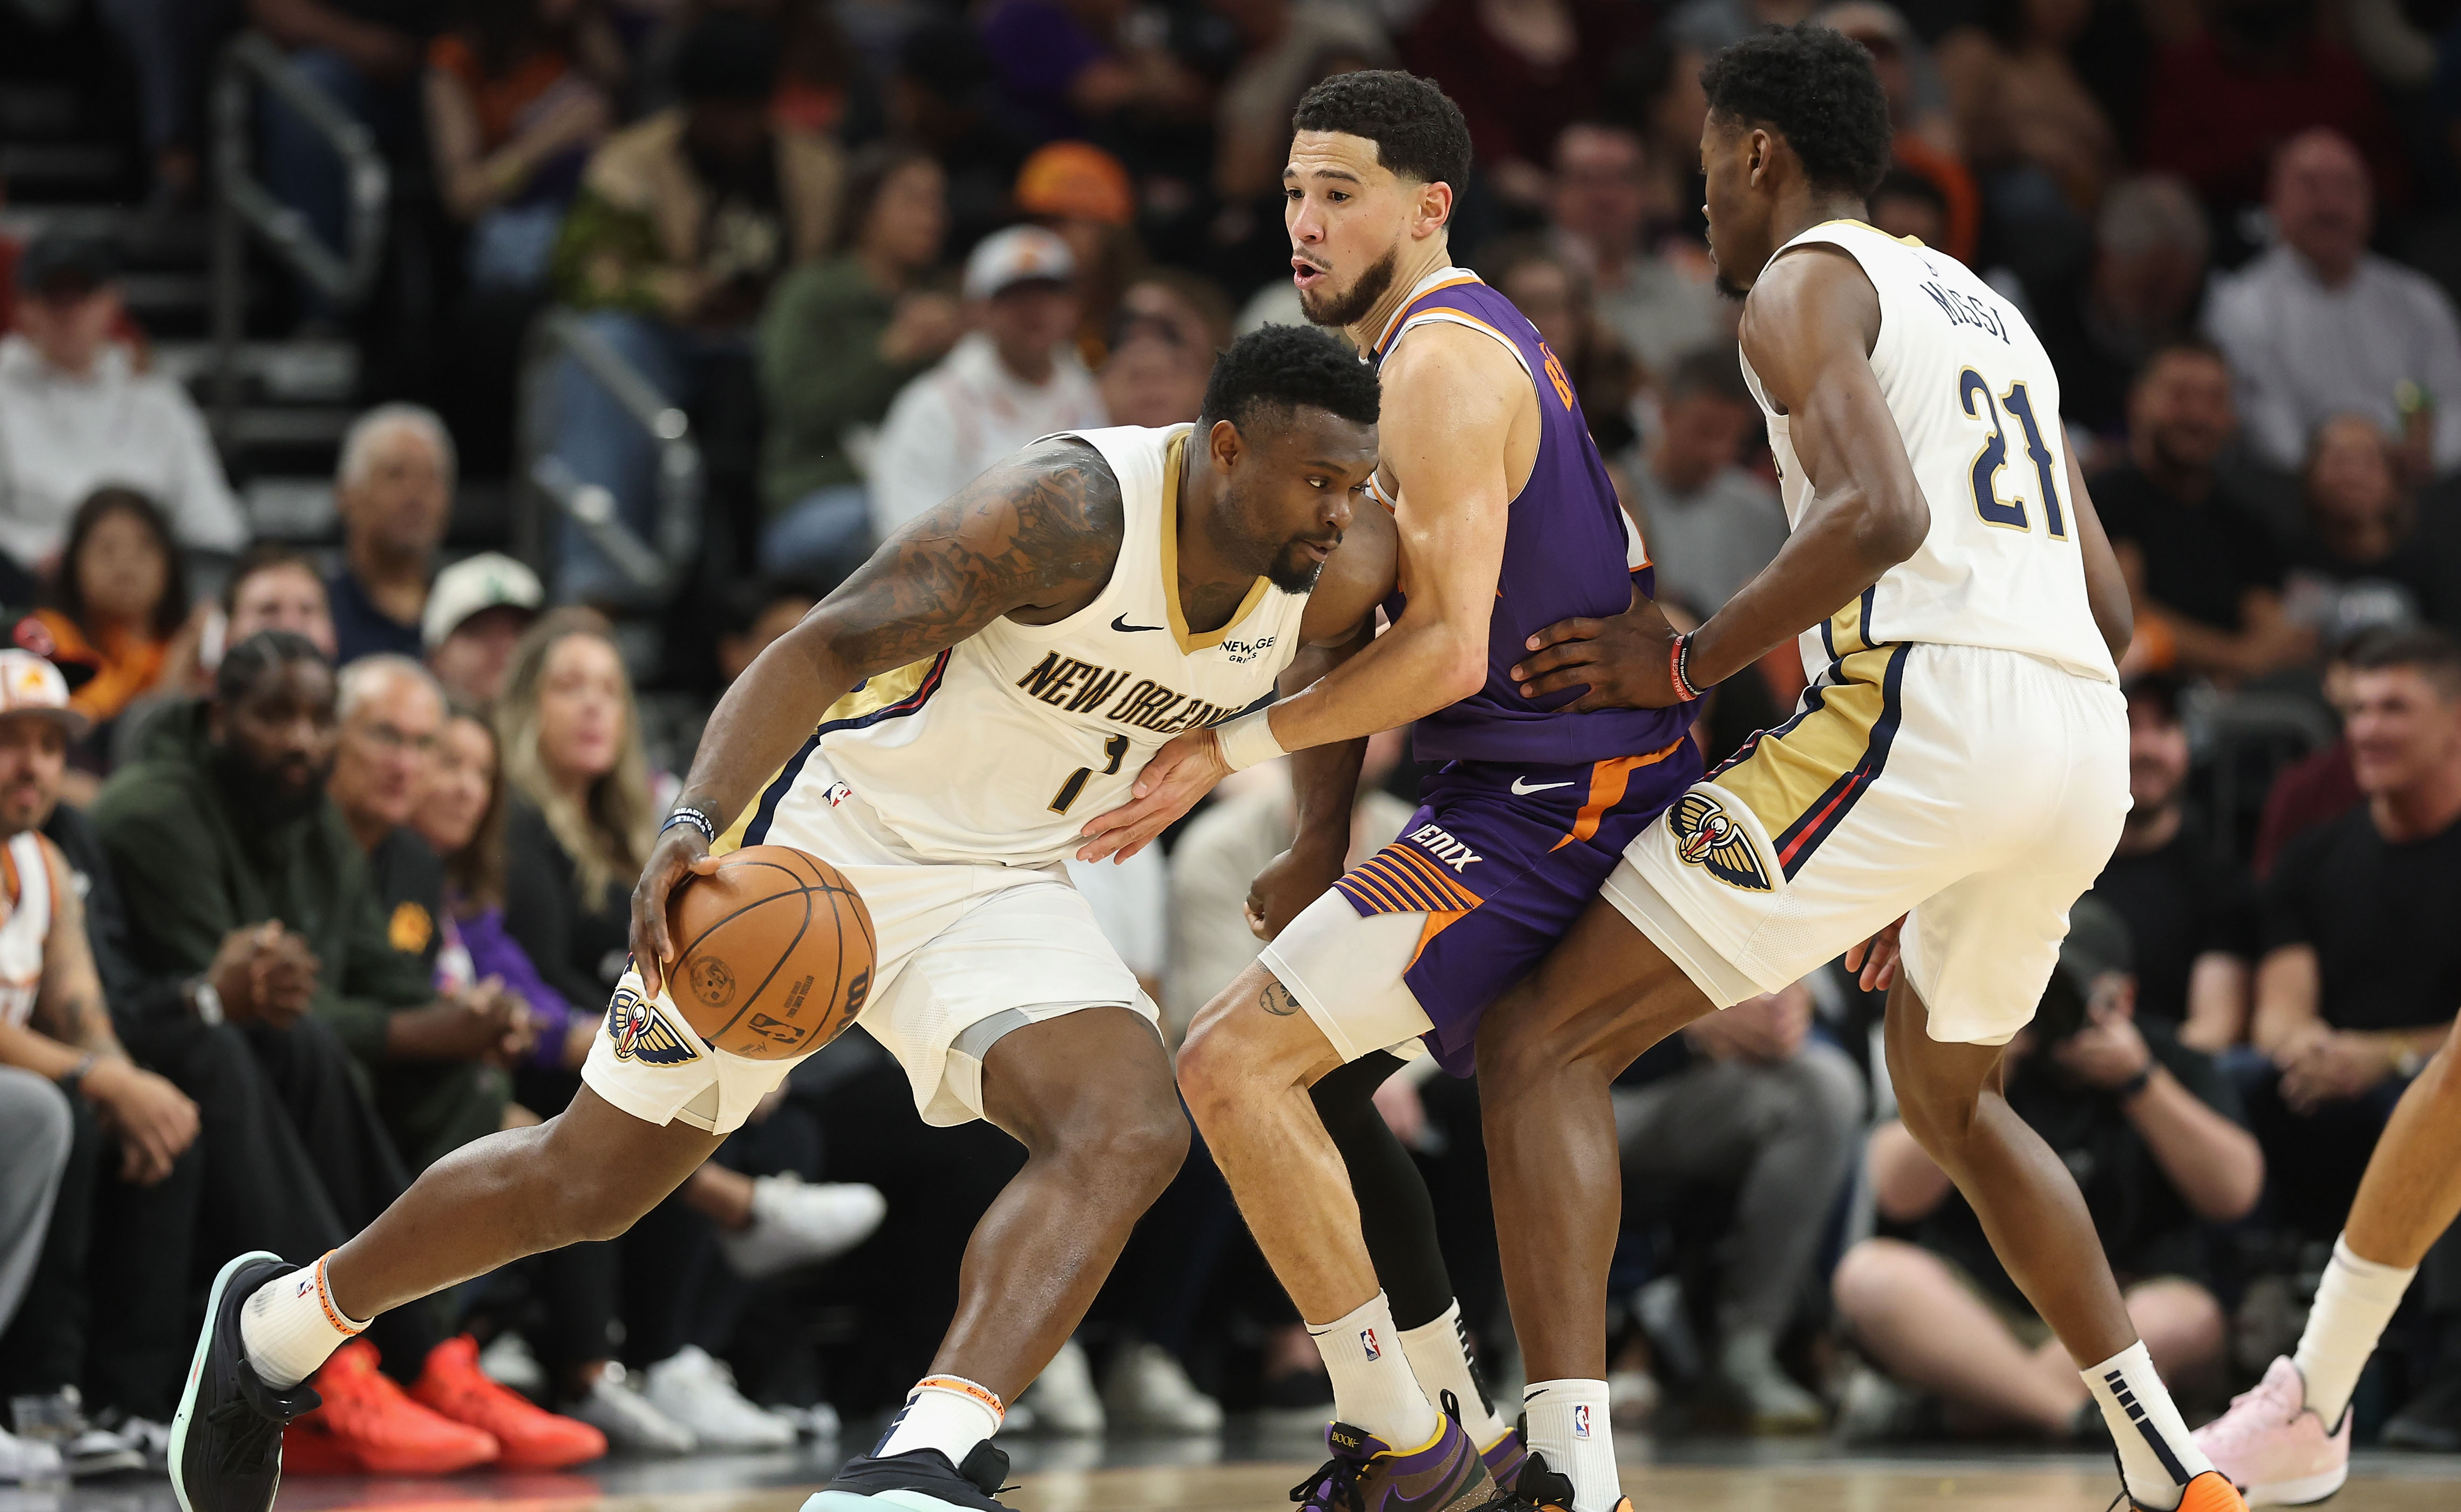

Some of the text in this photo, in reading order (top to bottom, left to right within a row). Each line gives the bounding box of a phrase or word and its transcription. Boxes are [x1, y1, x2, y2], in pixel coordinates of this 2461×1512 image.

[1919, 281, 2011, 346] MISSI
[1958, 365, 2068, 542] 21
[1219, 636, 1275, 655] NEWGE
[1016, 650, 1243, 734] NEW ORLEAN
[1047, 732, 1130, 816] 1
[673, 807, 713, 831] READY TO
[1404, 824, 1483, 874] ENIX
[1331, 1431, 1356, 1448] BOOK
